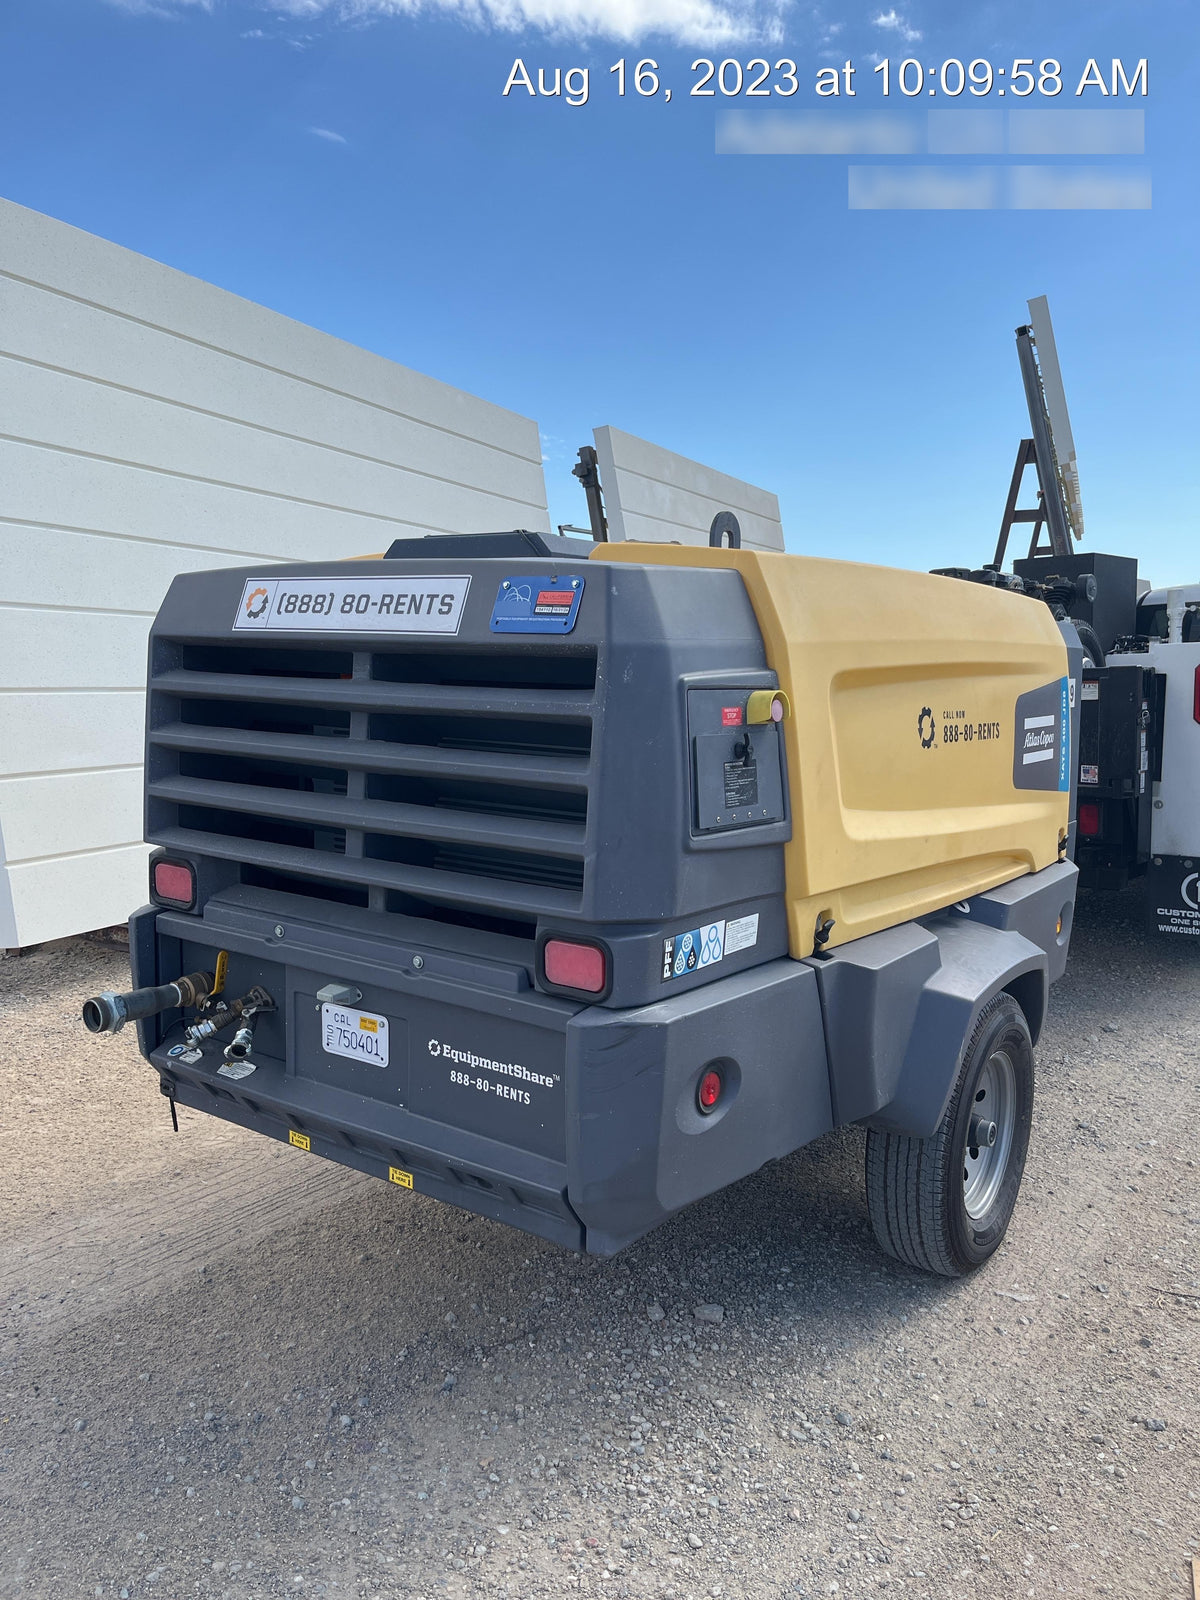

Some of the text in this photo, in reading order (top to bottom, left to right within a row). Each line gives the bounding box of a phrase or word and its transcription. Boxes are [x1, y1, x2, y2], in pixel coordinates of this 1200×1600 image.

[277, 592, 455, 616] (888) 80-RENTS
[943, 710, 965, 719] CALL NOW
[943, 722, 1000, 743] 888-80-RENTS
[663, 940, 673, 979] PFF
[334, 1012, 351, 1027] CAL
[335, 1026, 381, 1057] 750401
[442, 1043, 554, 1088] EquipmentShare
[450, 1070, 531, 1105] 888-80-RENTS
